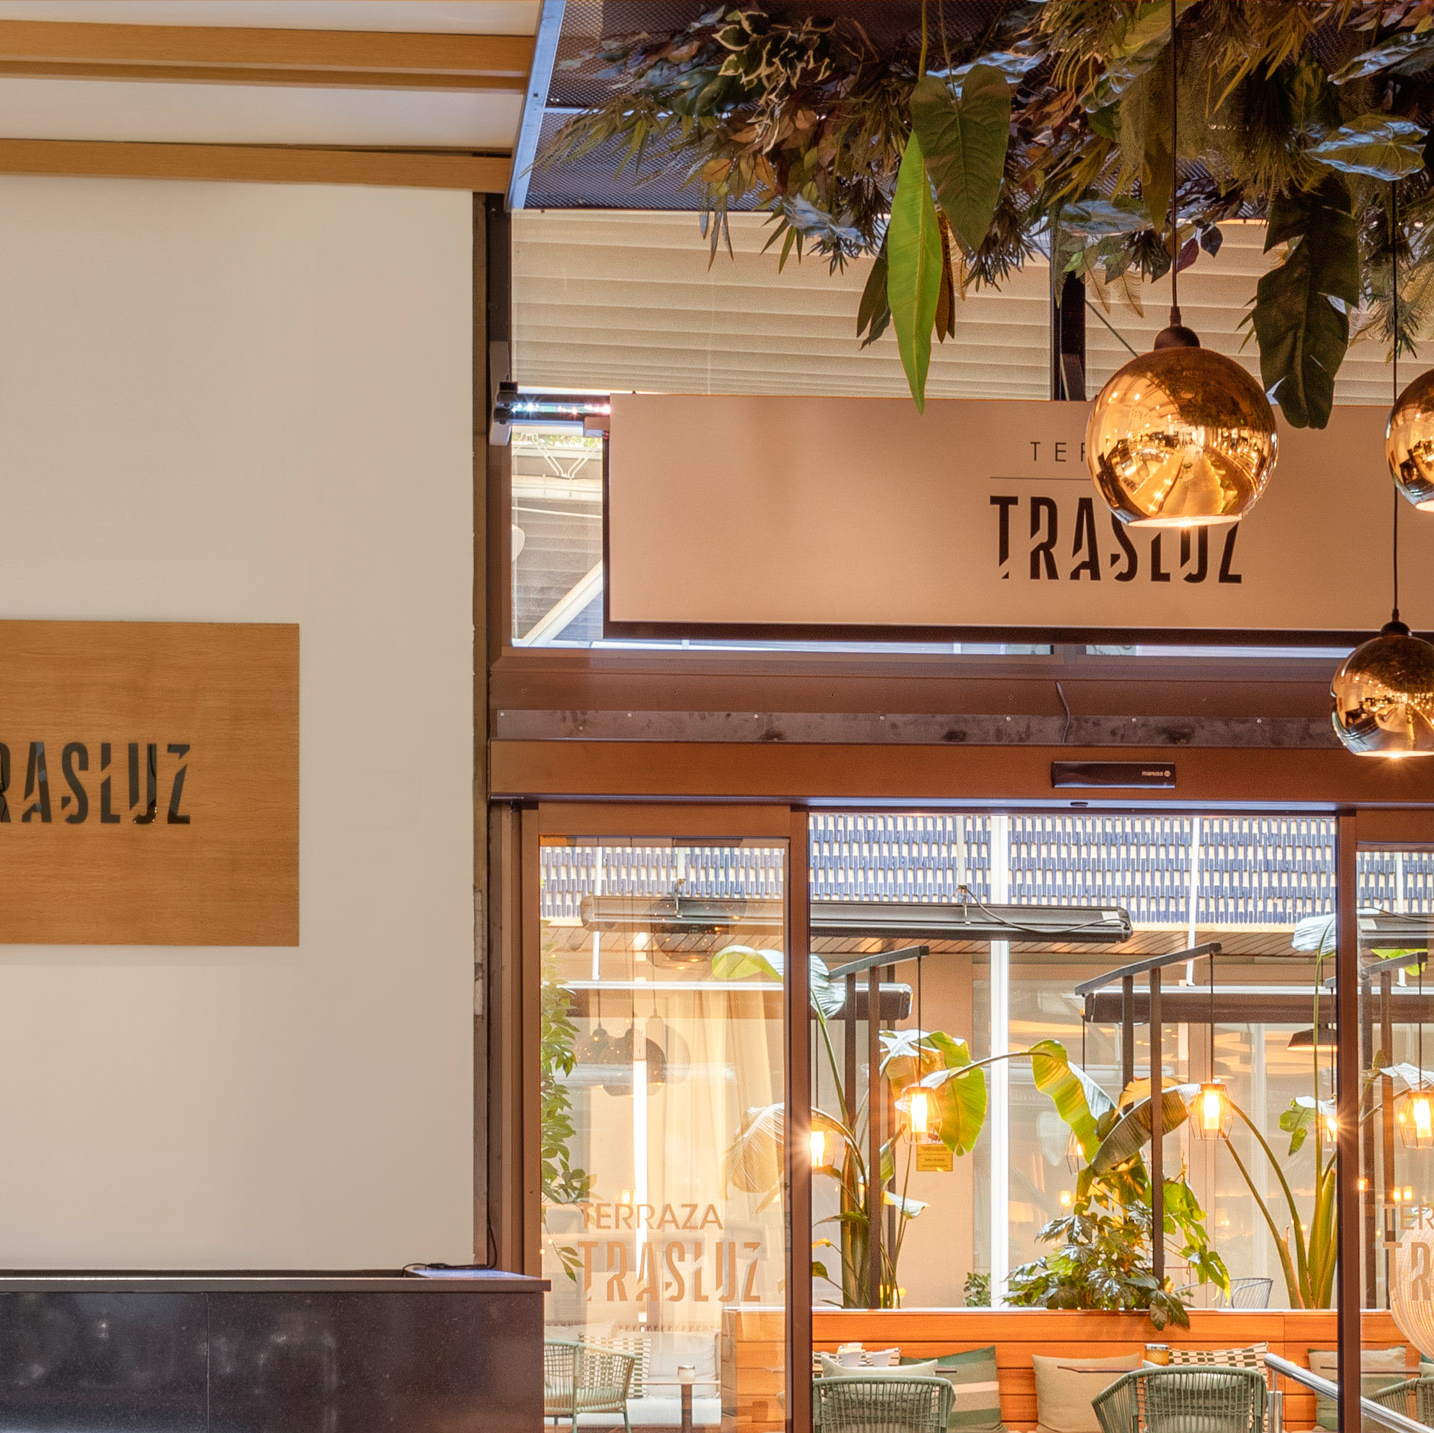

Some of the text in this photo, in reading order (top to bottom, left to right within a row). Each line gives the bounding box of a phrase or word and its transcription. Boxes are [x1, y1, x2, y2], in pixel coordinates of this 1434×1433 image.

[989, 495, 1242, 584] TRASLUZ
[578, 1202, 724, 1230] TERRAZA
[578, 1240, 761, 1302] TRASLUZ
